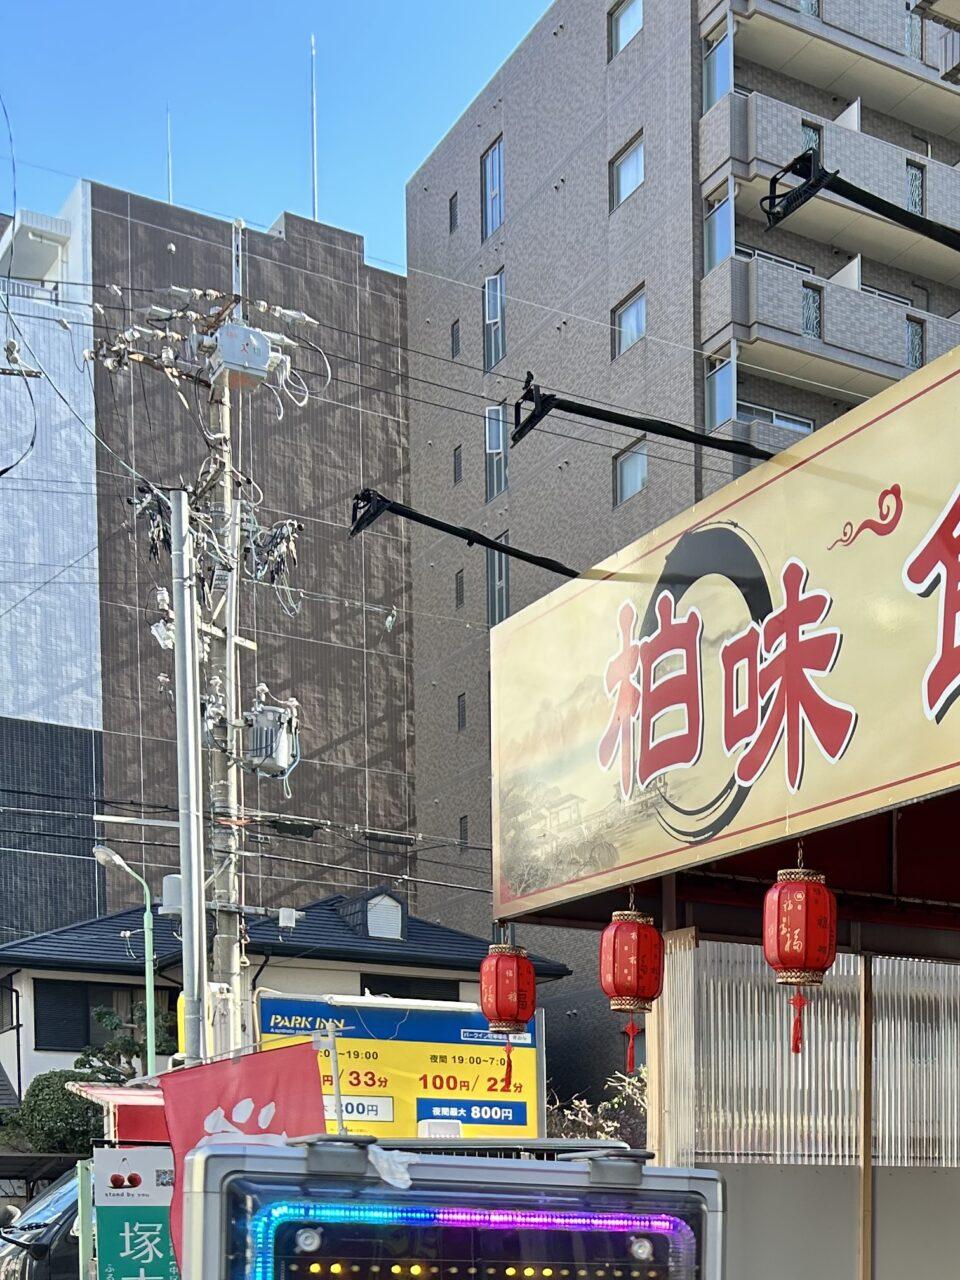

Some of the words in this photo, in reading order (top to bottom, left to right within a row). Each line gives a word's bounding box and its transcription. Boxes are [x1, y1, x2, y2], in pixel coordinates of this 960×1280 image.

[270, 1014, 313, 1028] PARK
[429, 1054, 448, 1064] 夜間
[432, 1107, 467, 1117] 夜間最大
[470, 1106, 513, 1121] 800円
